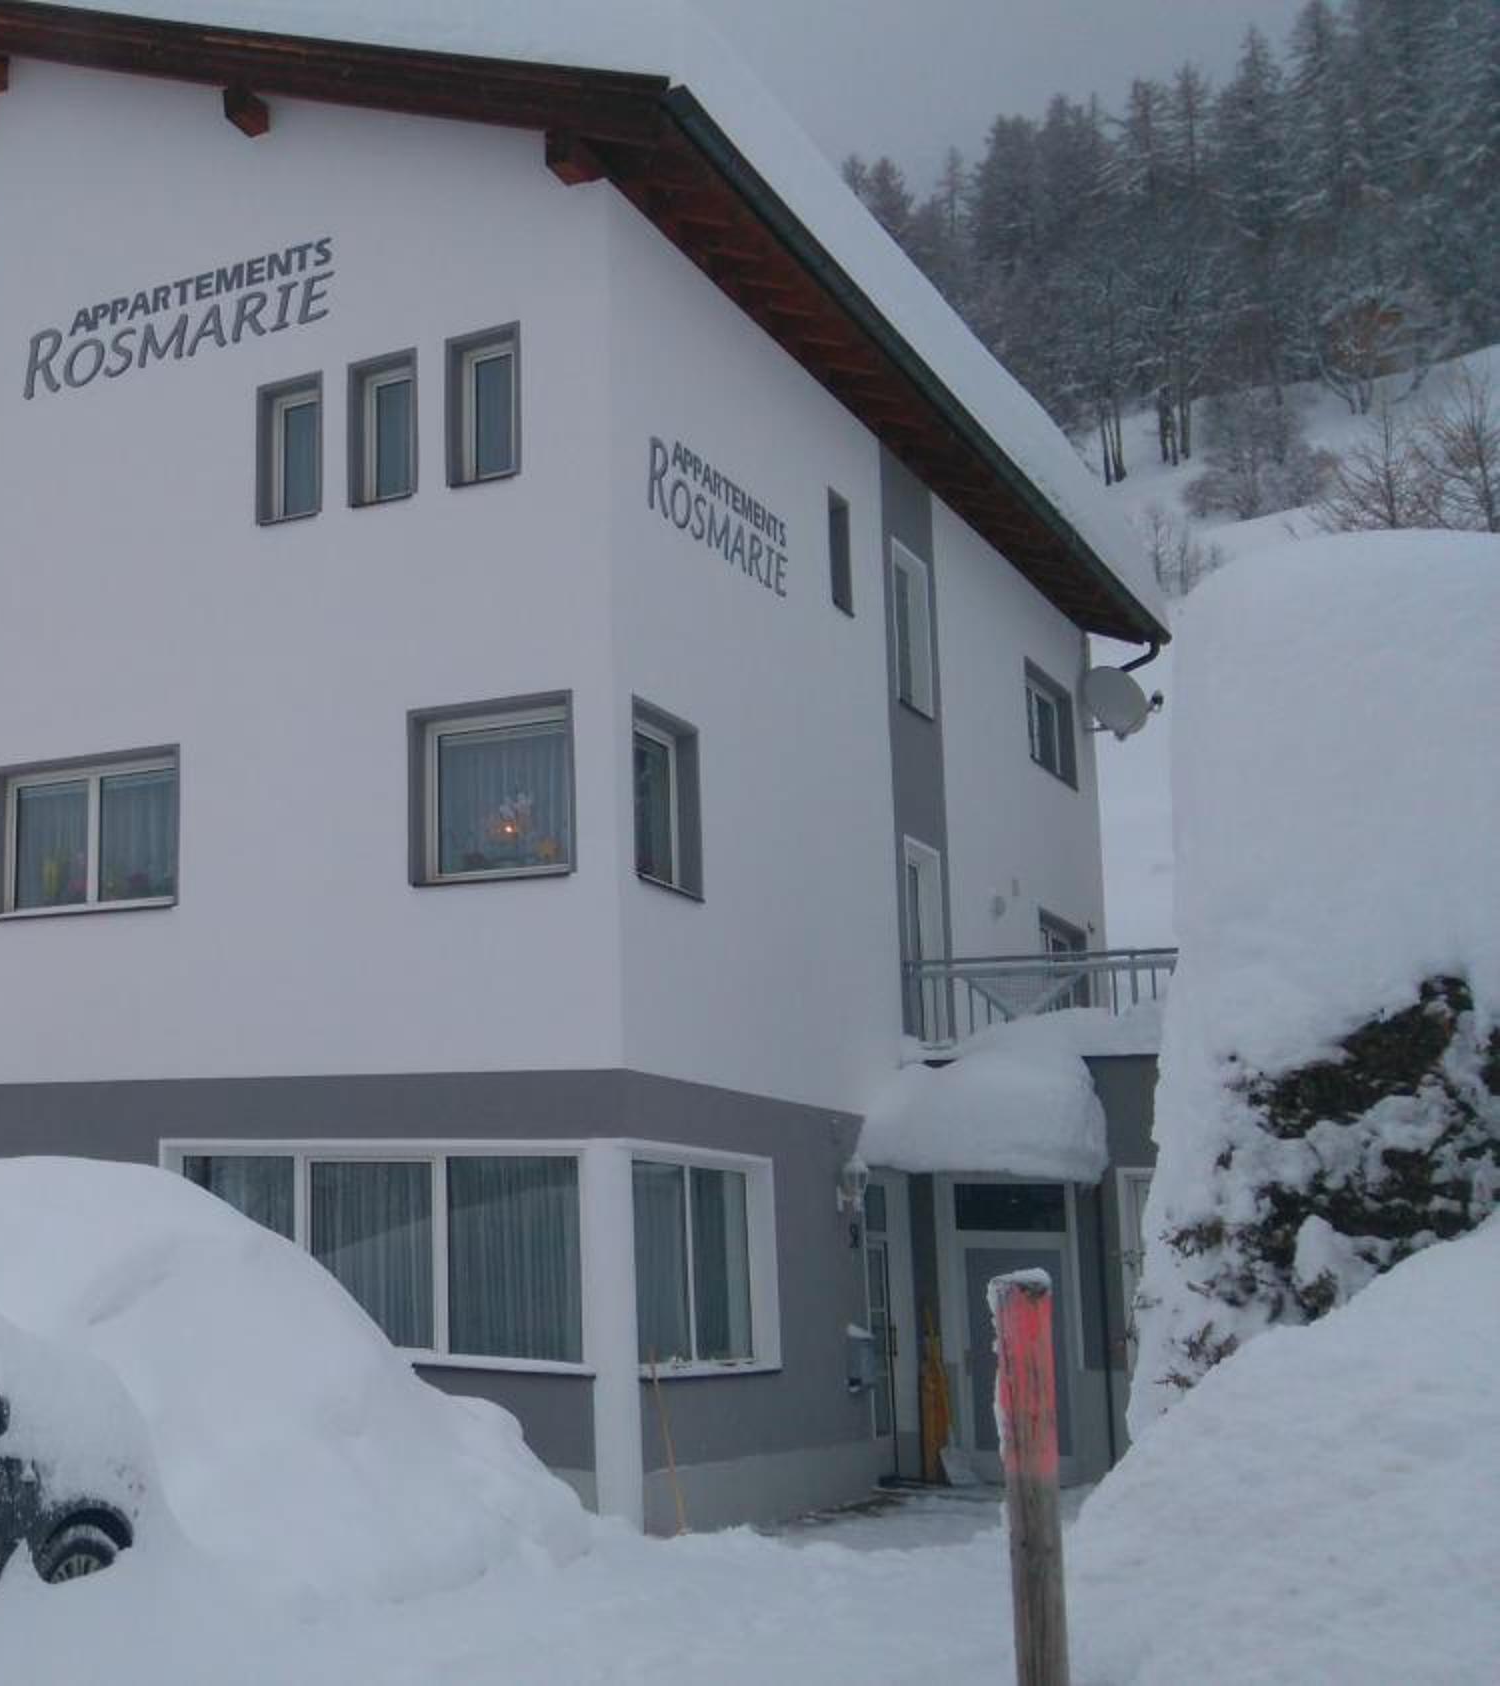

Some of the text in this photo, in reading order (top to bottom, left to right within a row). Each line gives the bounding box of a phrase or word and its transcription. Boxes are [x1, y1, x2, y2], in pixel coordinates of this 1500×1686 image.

[22, 270, 336, 401] ROSMARIE
[69, 236, 334, 336] APPARTEMENTS
[647, 436, 789, 599] ROSMARIE
[672, 440, 786, 547] APPARTEMENTS
